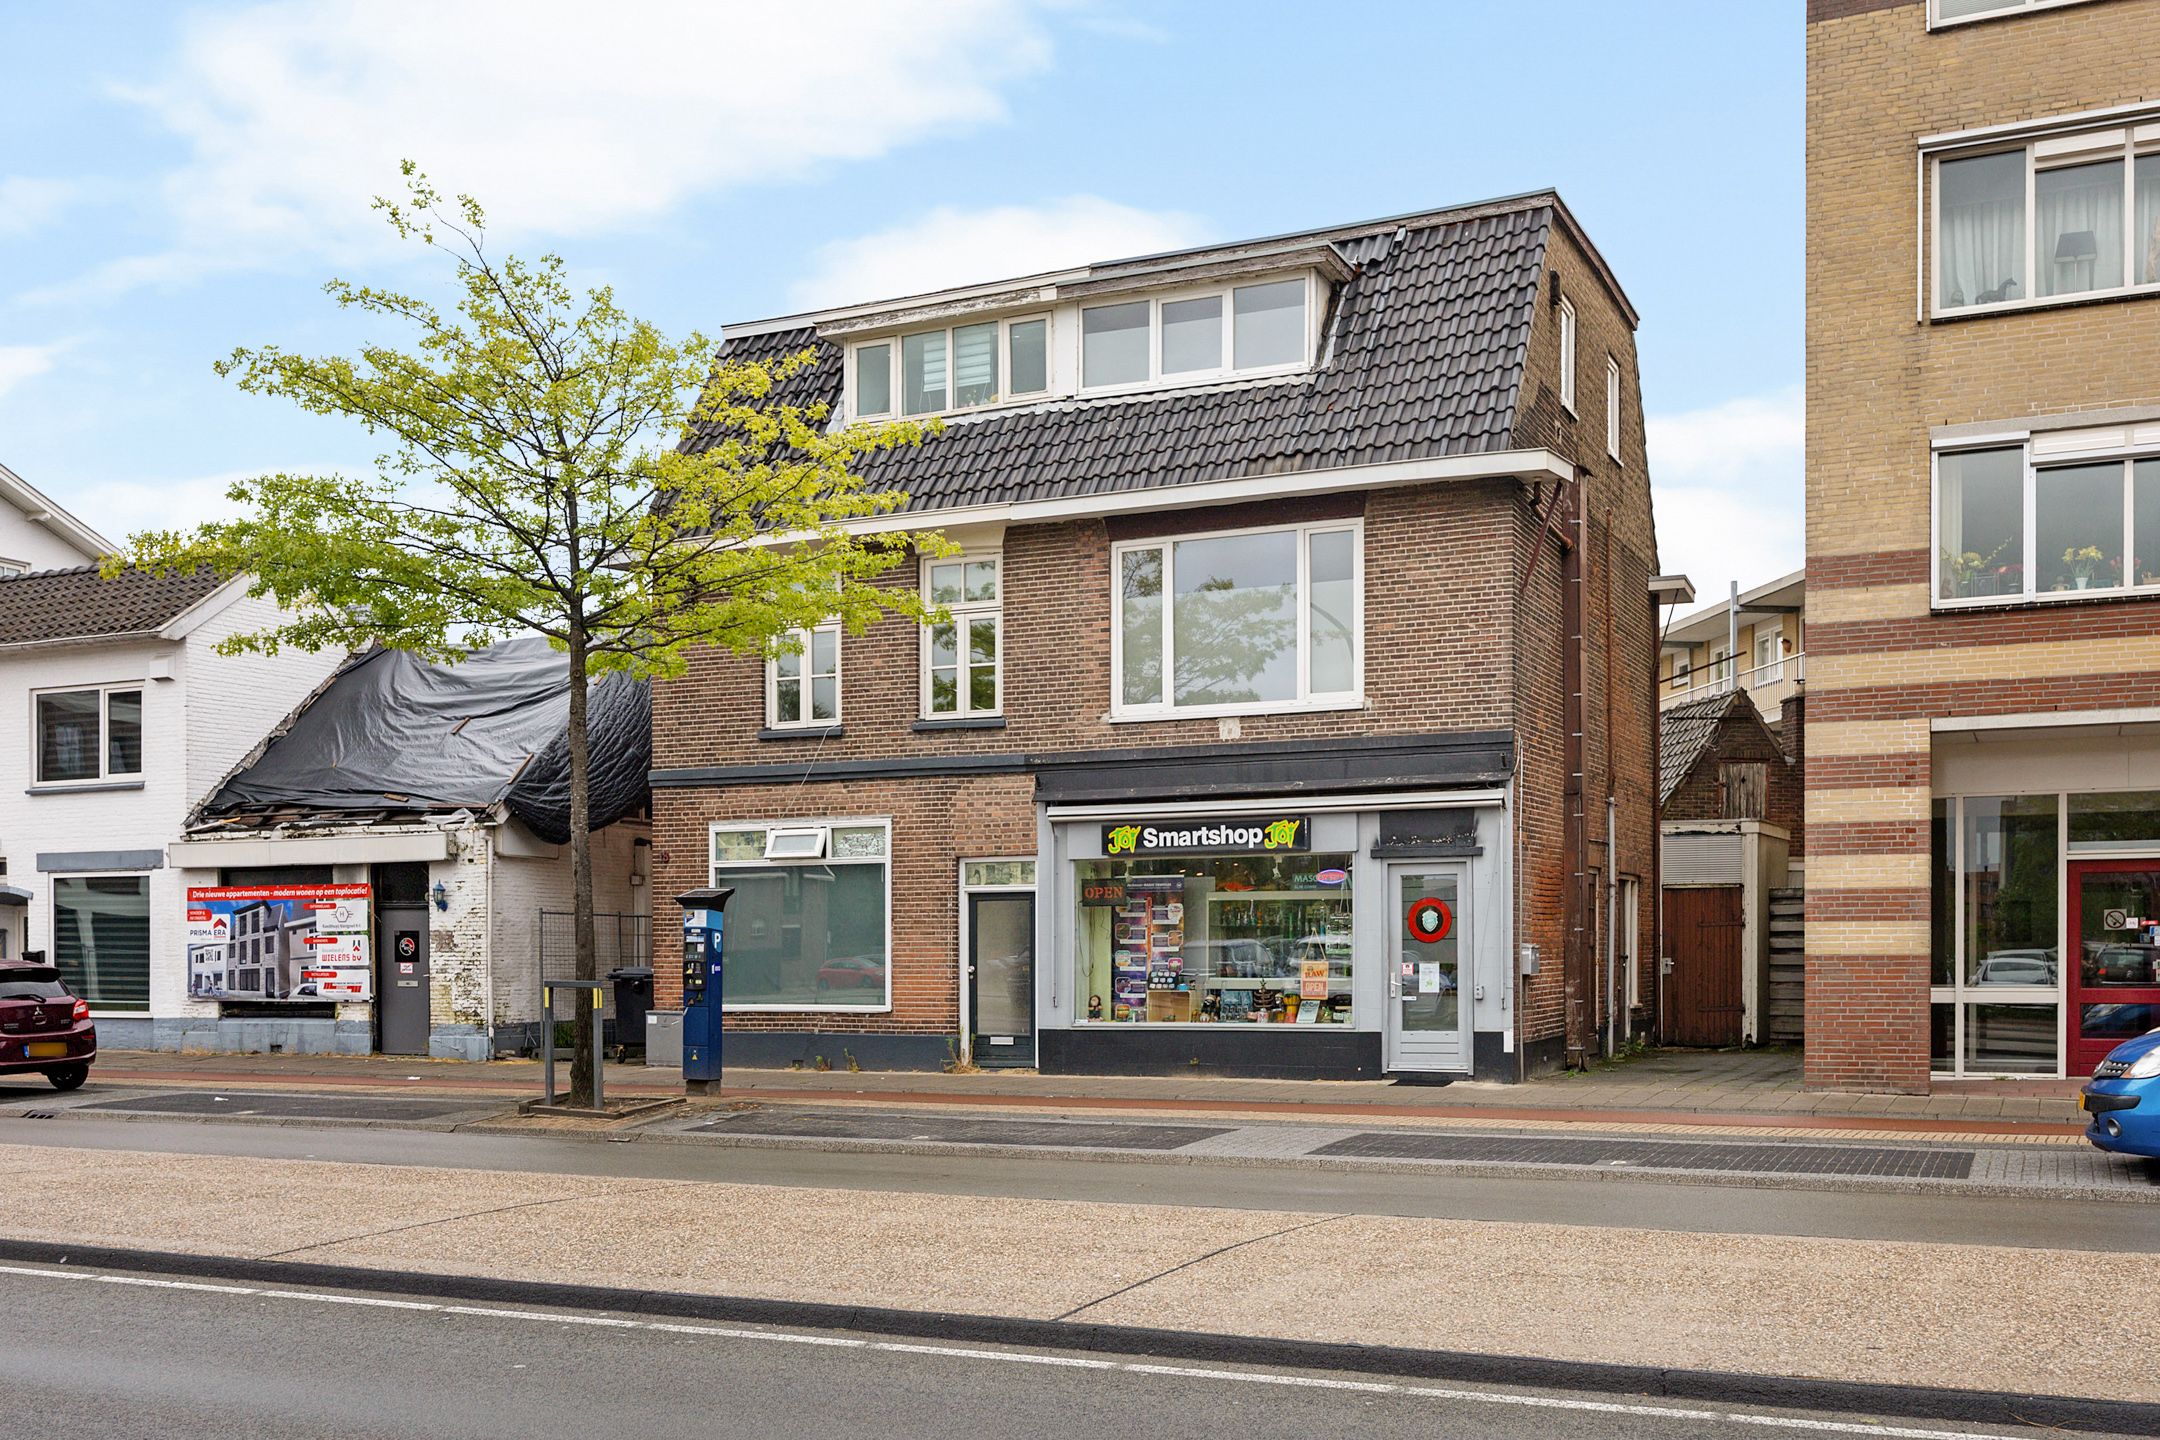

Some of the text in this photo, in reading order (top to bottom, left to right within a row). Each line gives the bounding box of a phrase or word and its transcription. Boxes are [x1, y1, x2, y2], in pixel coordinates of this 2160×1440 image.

[1108, 820, 1300, 854] JOY Smartshop JOY
[192, 890, 204, 898] Drie
[205, 890, 225, 898] nieuwe
[226, 890, 270, 899] appartementen
[273, 888, 295, 896] modern
[315, 889, 323, 898] op
[335, 887, 368, 897] toplocatie!
[1084, 886, 1124, 899] OPEN
[714, 932, 721, 949] P
[1305, 970, 1325, 978] RAW
[1305, 982, 1324, 992] OPEN
